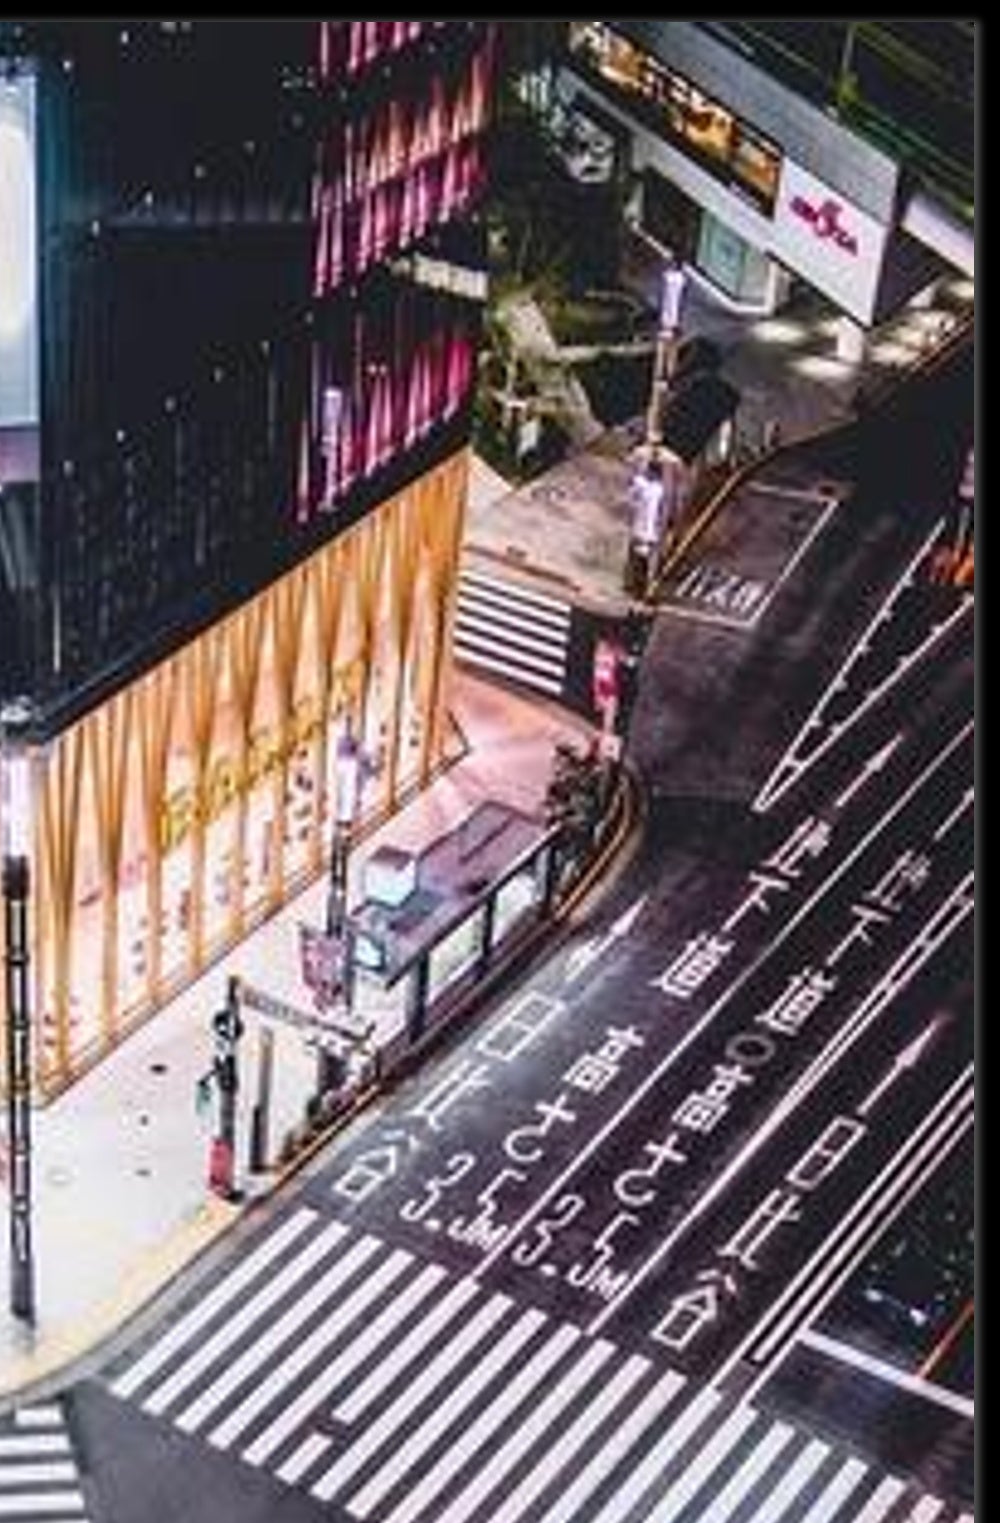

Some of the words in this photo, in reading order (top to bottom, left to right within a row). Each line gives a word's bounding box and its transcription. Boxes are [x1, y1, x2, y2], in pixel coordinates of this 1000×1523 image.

[331, 989, 568, 1202] 日比谷
[504, 1023, 646, 1163] 高さ
[612, 1062, 756, 1206] 高さ
[651, 1115, 867, 1352] 日比谷
